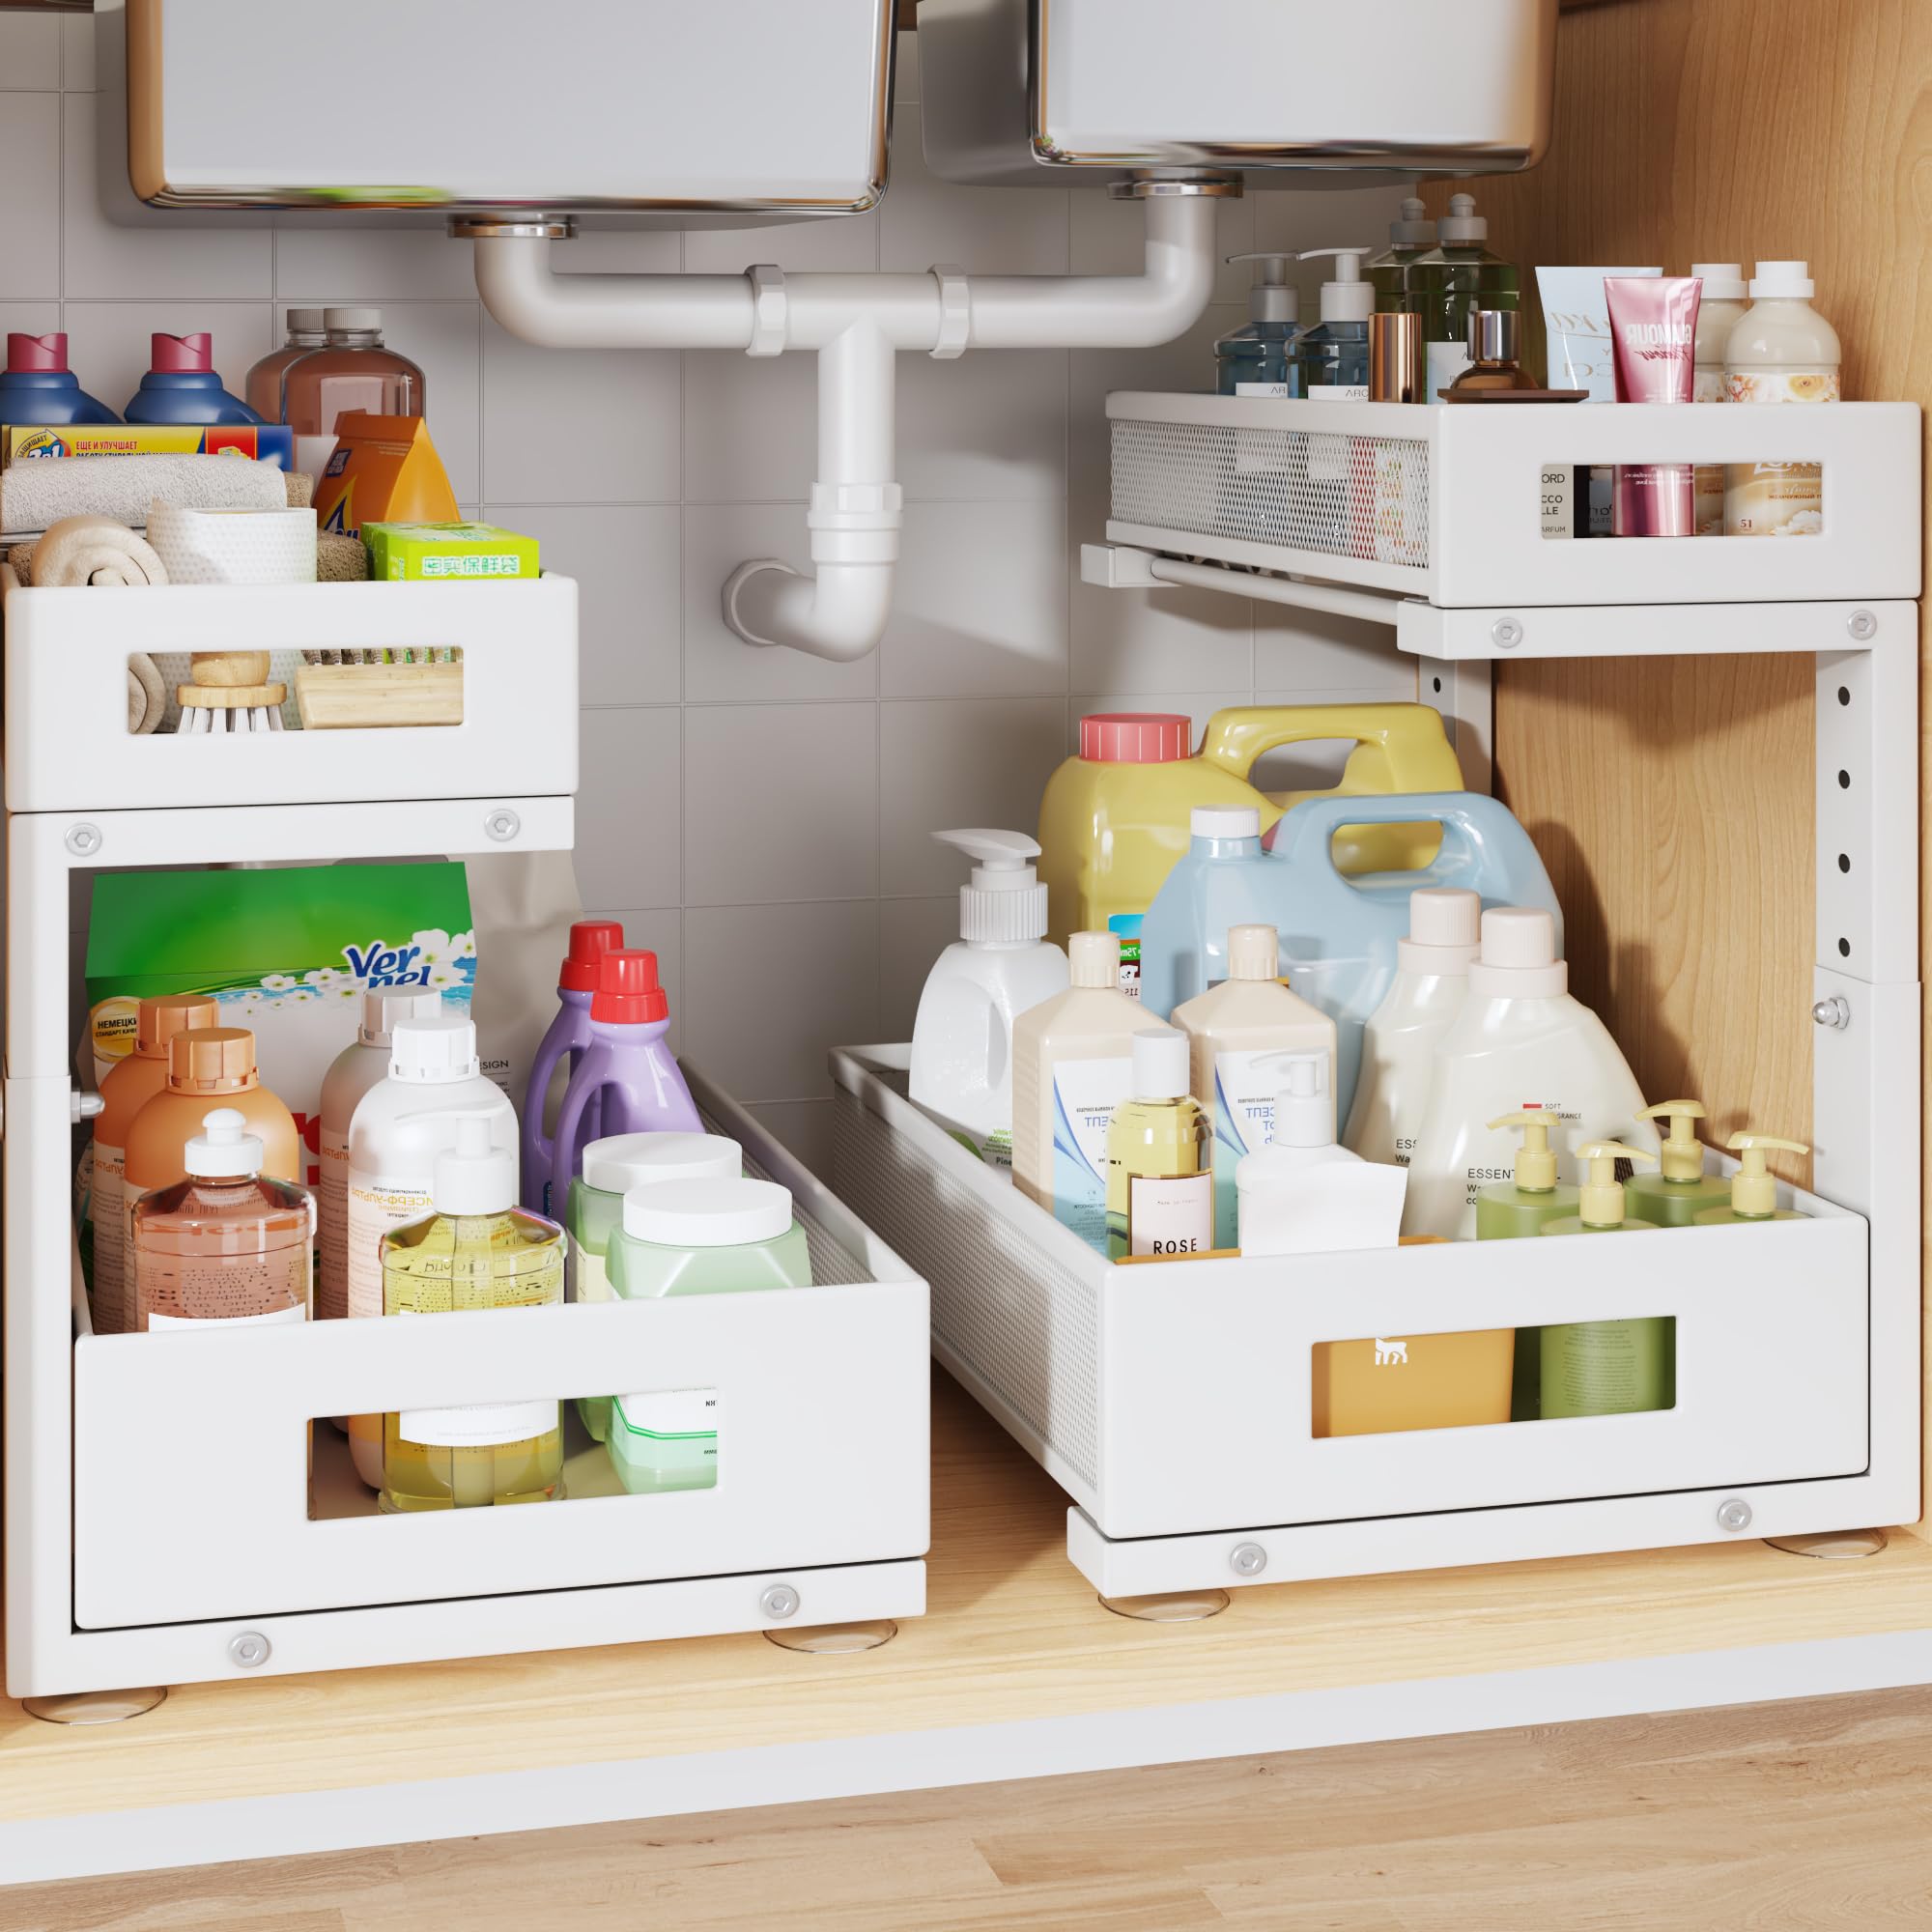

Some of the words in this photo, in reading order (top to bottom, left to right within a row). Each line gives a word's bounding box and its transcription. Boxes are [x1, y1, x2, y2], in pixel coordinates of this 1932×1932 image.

[76, 440, 92, 451] ЕЩЕ
[94, 441, 99, 450] И
[99, 440, 138, 450] УЛУЧШАЕТ
[346, 943, 421, 978] Ver
[368, 966, 432, 989] nel
[1153, 1237, 1197, 1254] ROSE
